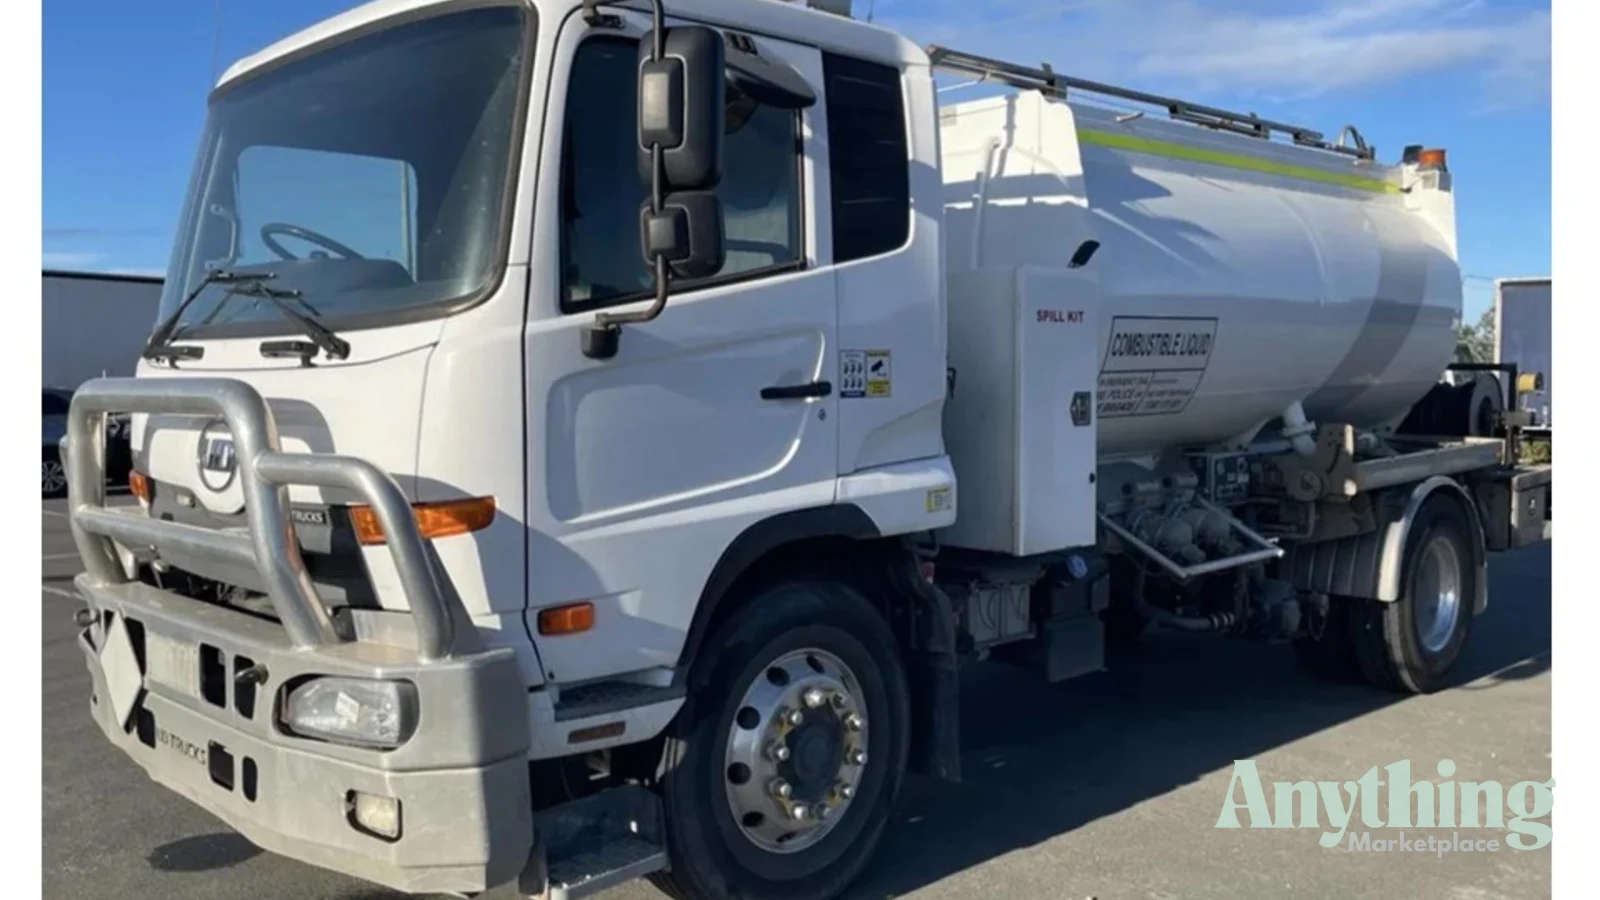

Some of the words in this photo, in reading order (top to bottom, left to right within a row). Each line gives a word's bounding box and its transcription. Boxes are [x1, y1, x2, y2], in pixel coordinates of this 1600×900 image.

[1036, 309, 1065, 322] SPILL
[1067, 310, 1085, 324] KIT
[1111, 332, 1181, 356] COMBUSTIBLE
[1179, 332, 1211, 355] LIQUID
[169, 732, 206, 765] TRUCKS
